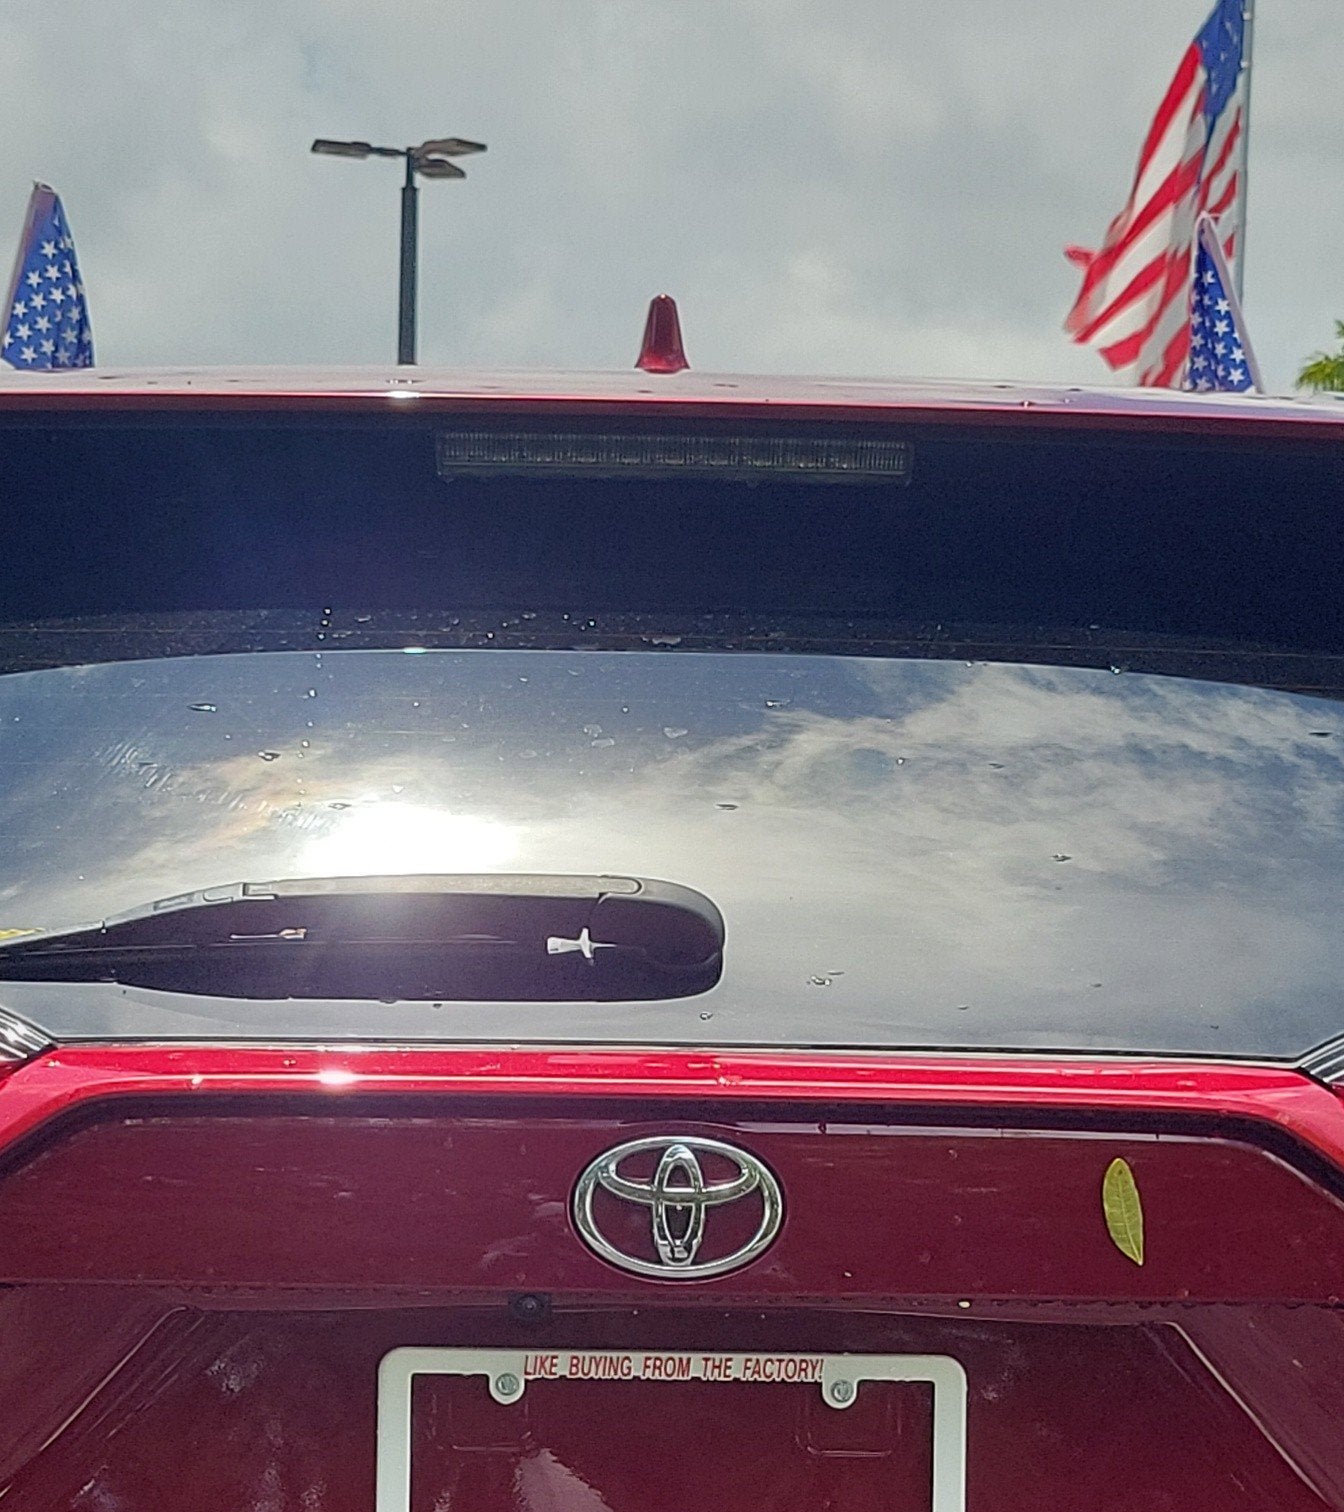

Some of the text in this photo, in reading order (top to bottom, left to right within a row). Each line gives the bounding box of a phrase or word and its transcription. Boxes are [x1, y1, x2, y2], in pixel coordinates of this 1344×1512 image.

[523, 1354, 825, 1381] LIKE BUYING FROM THE FACTORY!
